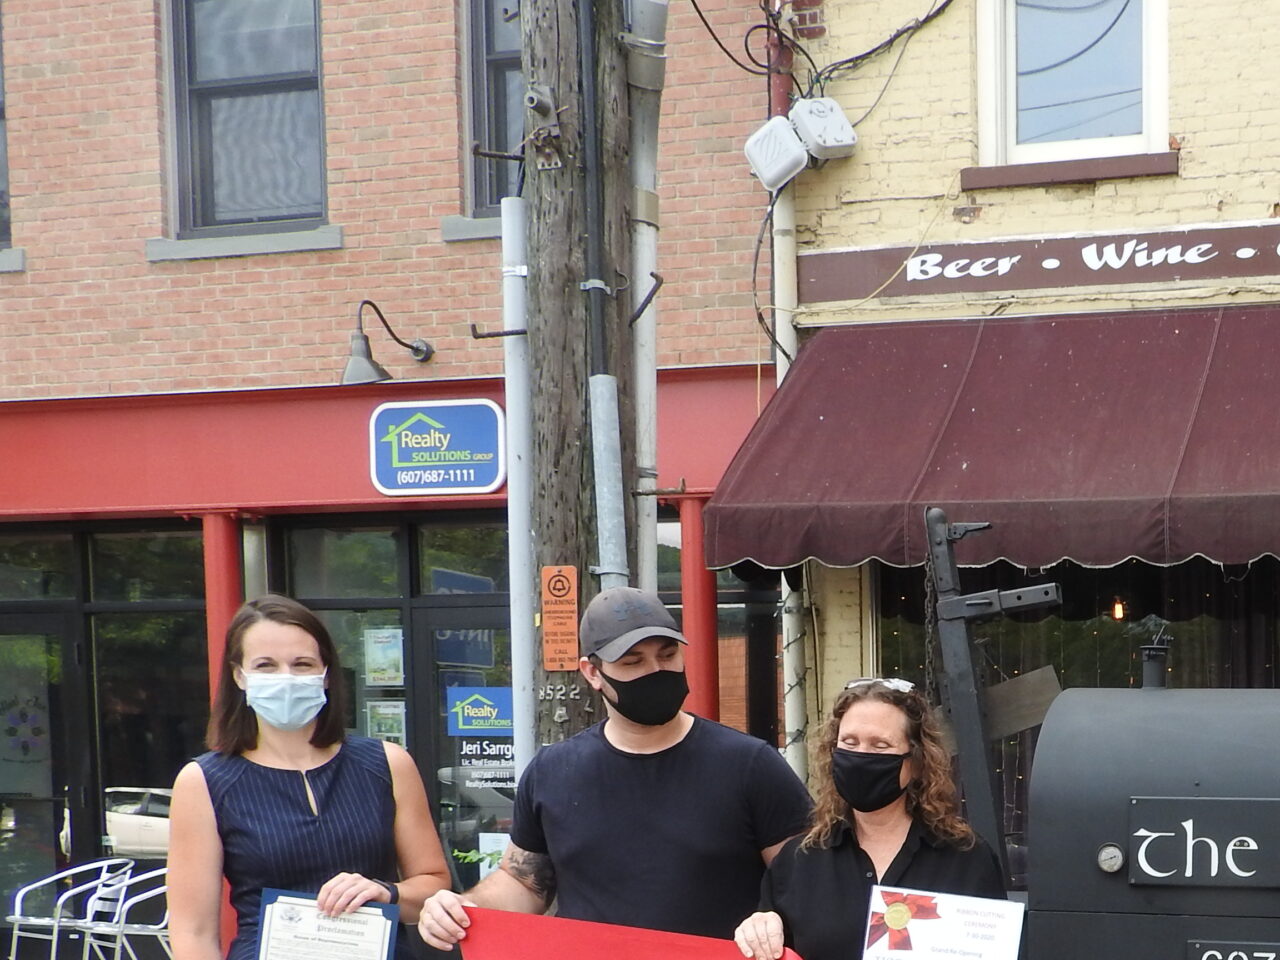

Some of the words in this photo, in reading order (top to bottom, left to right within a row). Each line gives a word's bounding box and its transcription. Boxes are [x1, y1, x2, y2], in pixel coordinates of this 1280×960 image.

[904, 252, 1021, 281] Beer
[1081, 239, 1219, 271] Wine
[401, 429, 450, 450] Realty
[412, 450, 471, 462] SOLUTIONS
[397, 469, 475, 485] (607)687-1111
[464, 705, 498, 719] Realty
[472, 719, 511, 727] SOLUTIONS
[460, 741, 481, 755] Jeri
[1132, 819, 1258, 878] the
